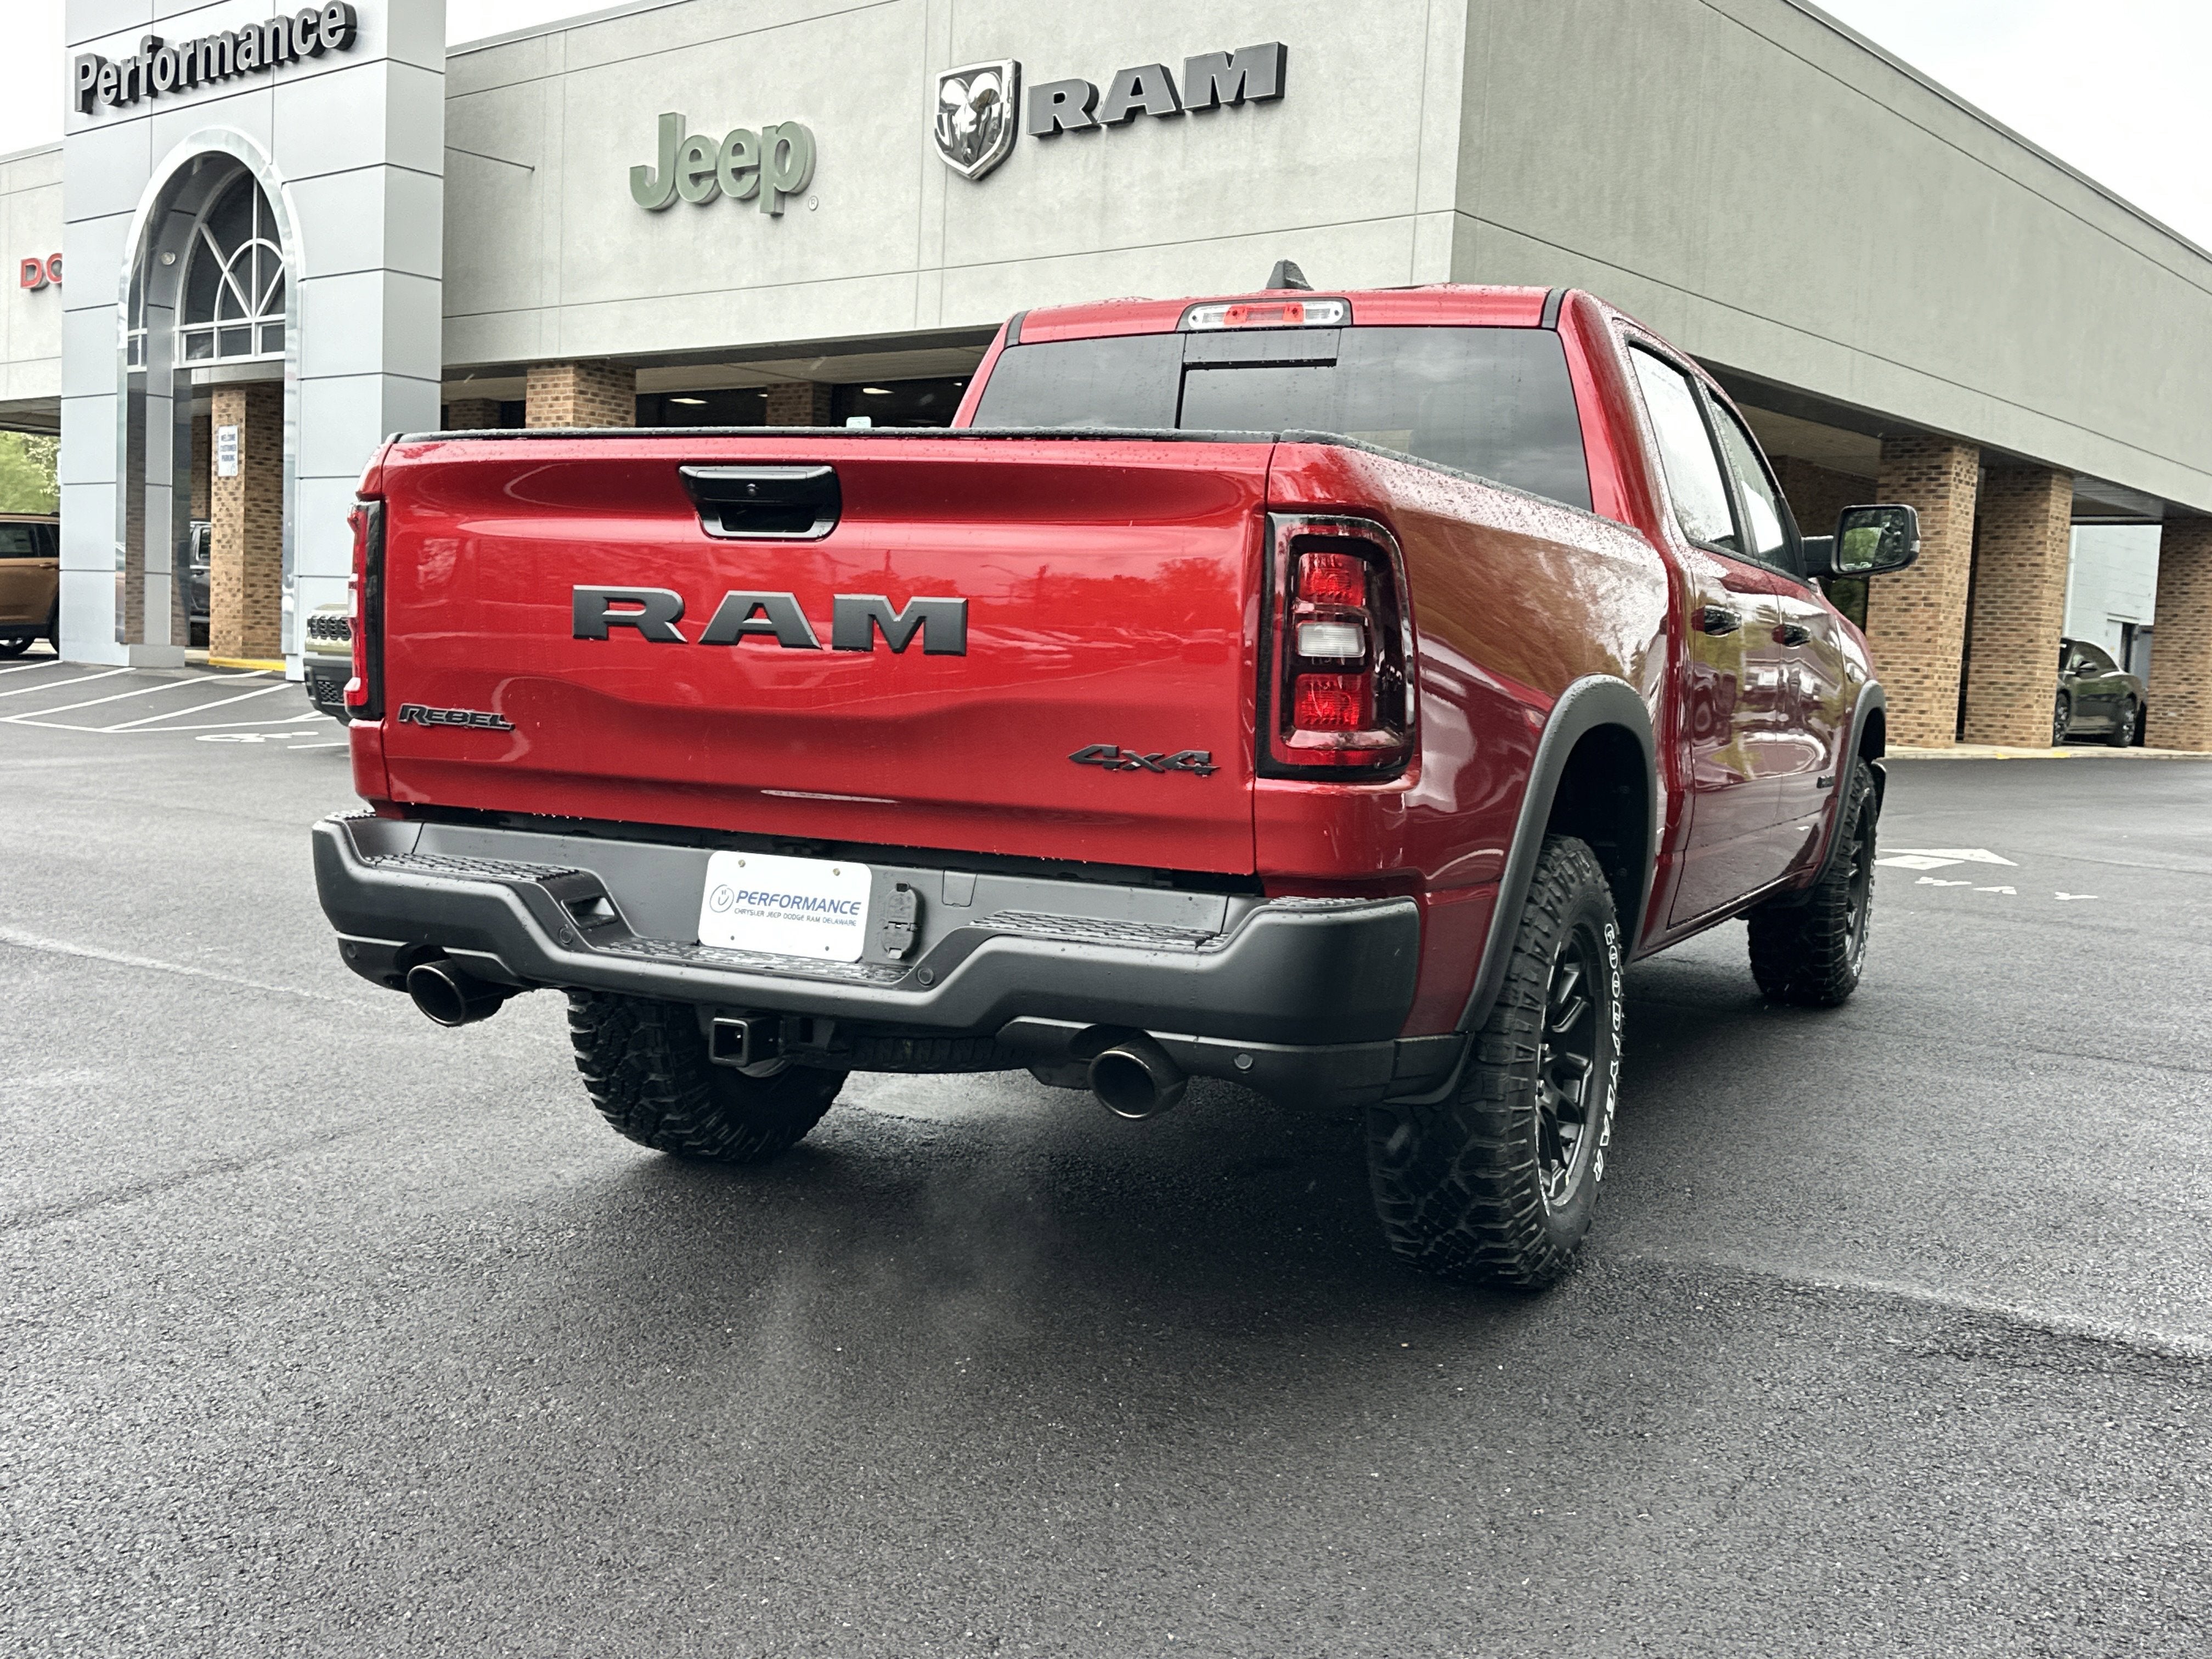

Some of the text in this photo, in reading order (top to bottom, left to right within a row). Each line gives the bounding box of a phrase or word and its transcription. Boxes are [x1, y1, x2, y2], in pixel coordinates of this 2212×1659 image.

[75, 1, 356, 113] Performance
[1027, 41, 1288, 137] RAM
[629, 111, 816, 215] Jeep
[572, 584, 968, 656] RAM
[398, 703, 515, 731] REBEL
[734, 908, 765, 917] CHRYSLER
[806, 915, 821, 923] RAM
[822, 917, 857, 927] DELAWARE
[736, 890, 861, 915] PERFORMANCE
[1594, 923, 1622, 1182] GOODYEAR
